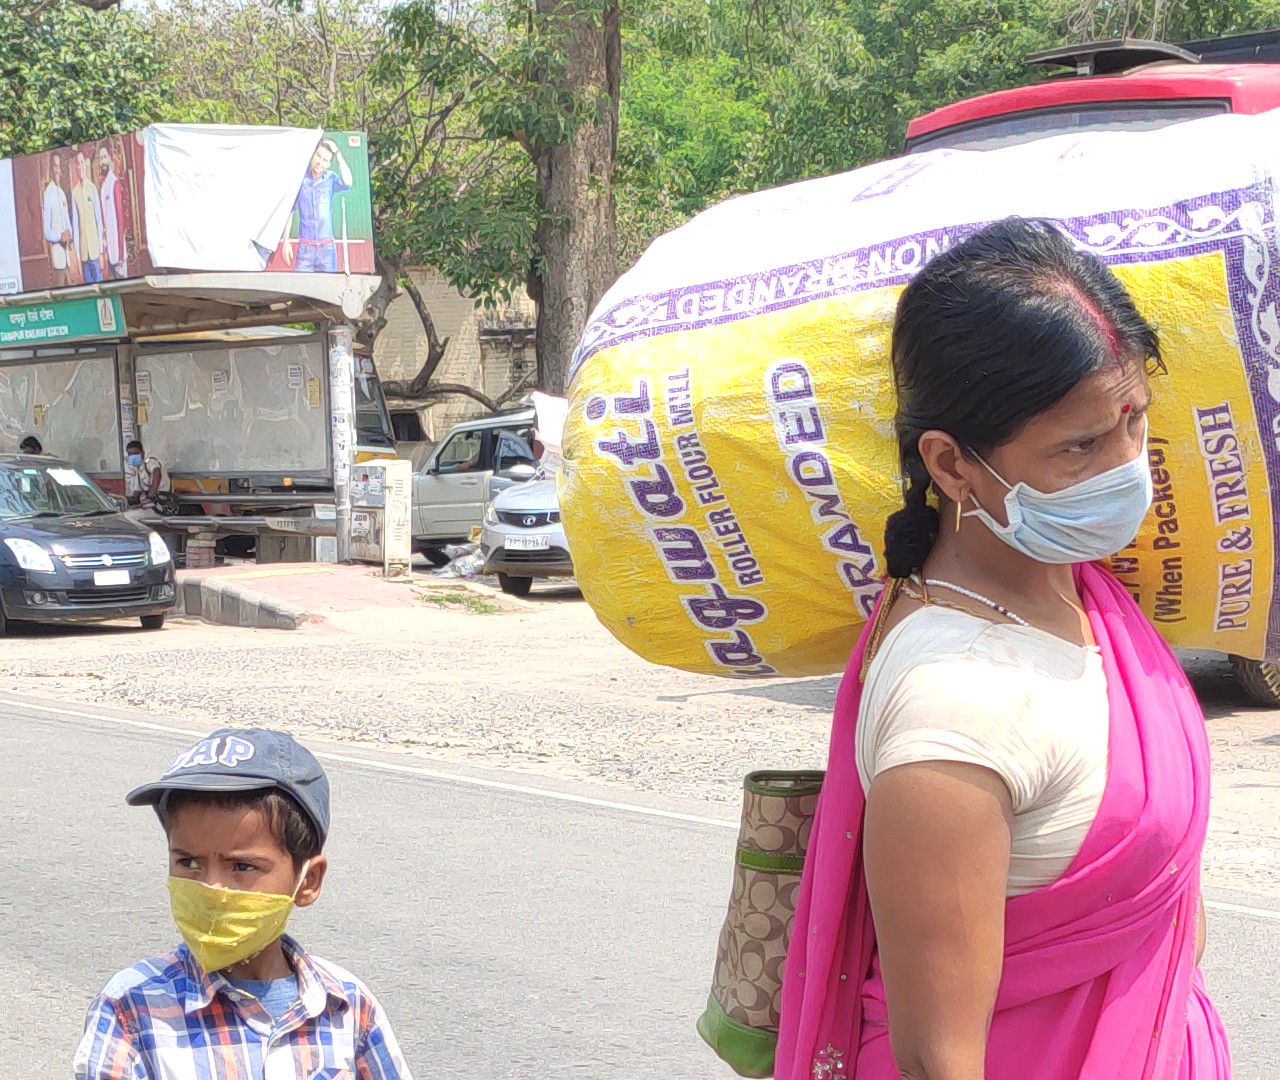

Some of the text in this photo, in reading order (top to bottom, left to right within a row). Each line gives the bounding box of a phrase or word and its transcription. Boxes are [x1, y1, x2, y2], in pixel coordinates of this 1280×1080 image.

[668, 367, 764, 587] ROLLER FLOUR MILL
[1196, 401, 1254, 631] PURE & FRESH
[1153, 556, 1187, 623] (When
